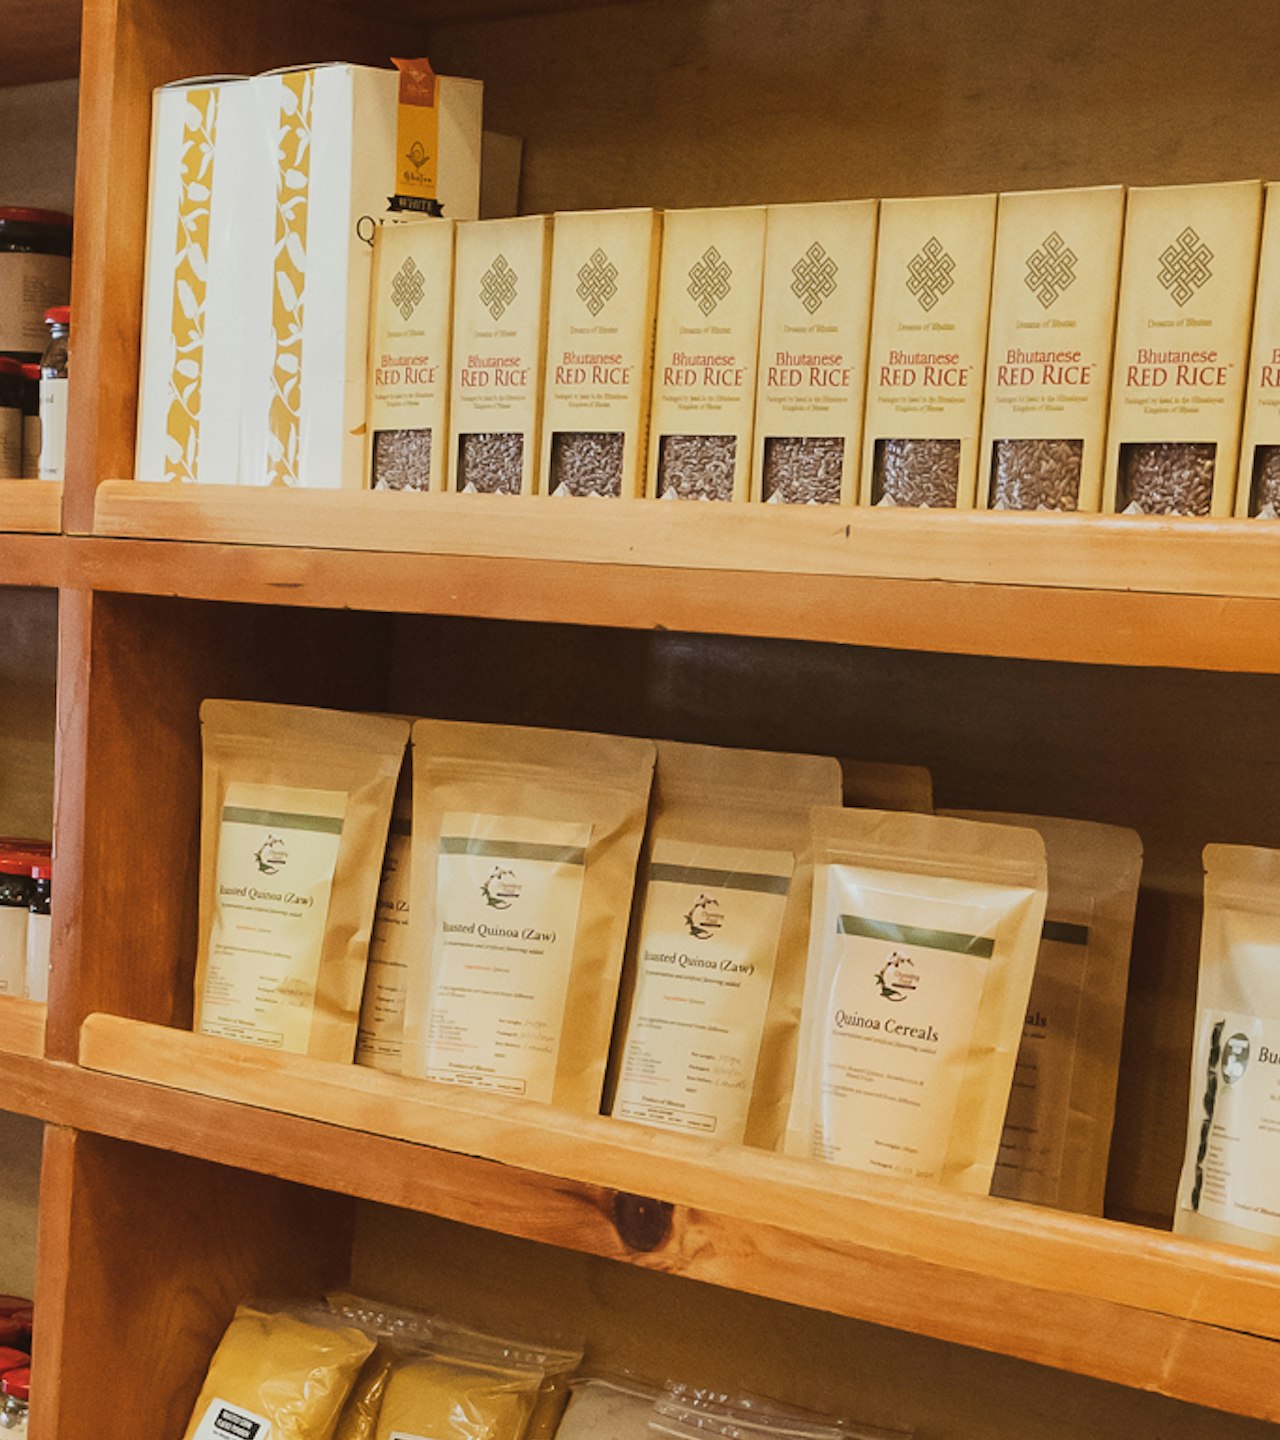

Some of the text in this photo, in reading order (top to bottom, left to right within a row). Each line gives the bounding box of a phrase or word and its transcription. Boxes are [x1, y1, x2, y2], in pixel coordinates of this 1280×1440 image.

[380, 354, 429, 367] Bhutanese
[467, 355, 520, 368] Bhutanese
[563, 351, 622, 366] Bhutanese
[672, 352, 736, 367] Bhutanese
[776, 352, 843, 367] Bhutanese
[889, 350, 959, 365] Bhutanese
[1006, 349, 1081, 365] Bhutanese
[1137, 349, 1218, 365] Bhutanese
[375, 367, 436, 386] RED RICE
[461, 369, 527, 387] RED RICE
[555, 366, 630, 385] RED RICE
[663, 367, 743, 386] RED RICE
[767, 367, 850, 387] RED RICE
[879, 367, 969, 387] RED RICE
[997, 364, 1090, 386] RED RICE
[1126, 365, 1227, 387] RED RICE
[477, 923, 557, 944] Quinoa (Zaw)
[678, 953, 755, 976] Quinoa (Zaw)
[835, 1009, 939, 1043] Quinoa Cereals
